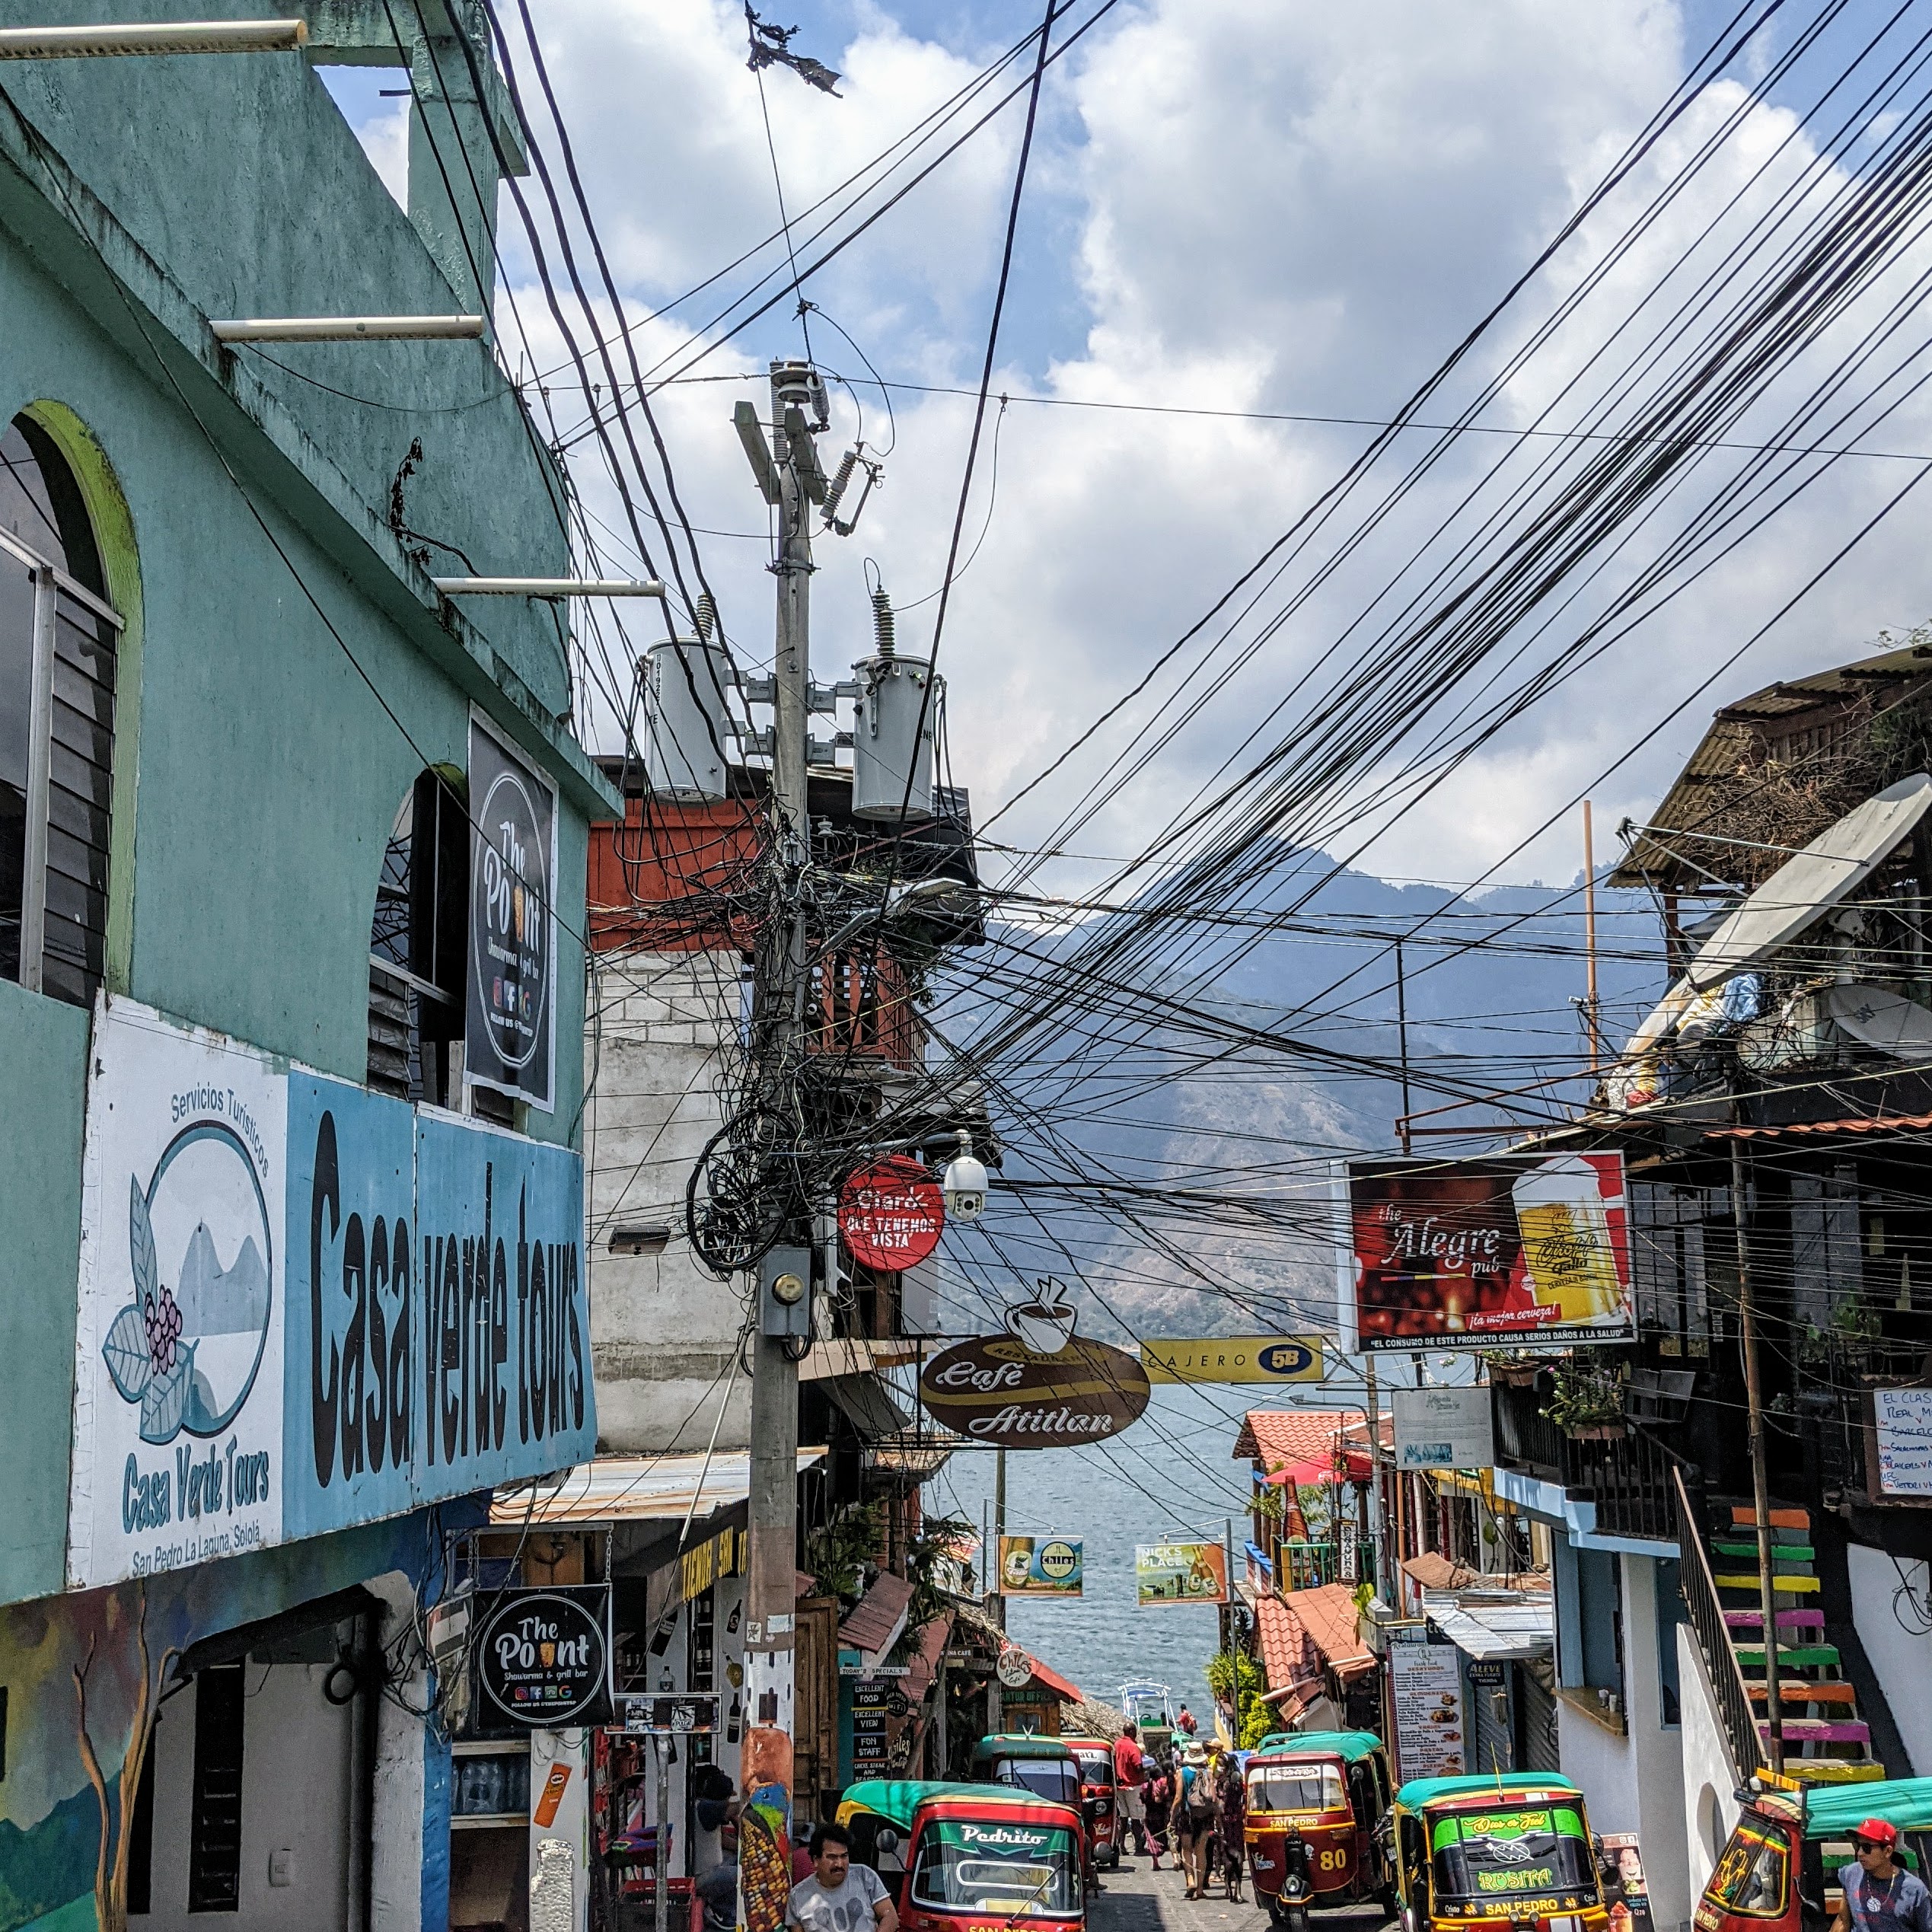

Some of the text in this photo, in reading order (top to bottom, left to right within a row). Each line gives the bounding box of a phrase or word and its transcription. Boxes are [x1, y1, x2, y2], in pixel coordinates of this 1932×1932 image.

[499, 821, 525, 881] The
[171, 1082, 269, 1178] Servicios Turísticos
[876, 1217, 936, 1232] TENEMOS
[1381, 1216, 1500, 1269] Alegre
[1471, 1255, 1500, 1278] pub
[311, 1110, 584, 1488] Casa verde tours
[1517, 1301, 1555, 1321] cerveza!
[1385, 1338, 1423, 1347] CONSUMO
[1425, 1337, 1435, 1346] DE
[1436, 1336, 1455, 1345] ESTE
[1457, 1334, 1497, 1344] PRODUCTO
[1499, 1334, 1523, 1342] CAUSA
[1525, 1331, 1551, 1341] SERIOS
[1553, 1329, 1577, 1340] DAÑOS
[1148, 1350, 1299, 1369] CAJERO 5B
[936, 1361, 1025, 1392] Café
[1884, 1394, 1897, 1403] EL
[968, 1405, 1112, 1434] Atitlan
[1887, 1407, 1913, 1418] REAL
[123, 1434, 269, 1534] Casa Verde Tours
[132, 1551, 151, 1577] San
[154, 1542, 183, 1571] Pedro
[185, 1538, 196, 1560] La
[234, 1519, 260, 1548] Sololá
[1041, 1556, 1075, 1565] Chiles
[1142, 1557, 1182, 1568] PLACE
[682, 1538, 713, 1604] TIENDA
[518, 1616, 558, 1640] The
[999, 1652, 1032, 1674] Chiles
[504, 1668, 588, 1681] Shawarma & grill bar
[859, 1694, 879, 1703] FOOD
[854, 1710, 885, 1718] EXCELLENT
[860, 1720, 878, 1728] VIEW
[859, 1748, 882, 1756] STAFF
[1288, 1818, 1318, 1827] PEDRO
[1464, 1817, 1505, 1833] Dios
[1519, 1812, 1545, 1830] Fiel
[962, 1824, 1048, 1844] Pedrito
[1320, 1848, 1347, 1871] 80
[1478, 1867, 1553, 1892] ROSITA
[1486, 1899, 1558, 1915] SAN PEDRO
[1703, 1911, 1718, 1930] PEDRO
